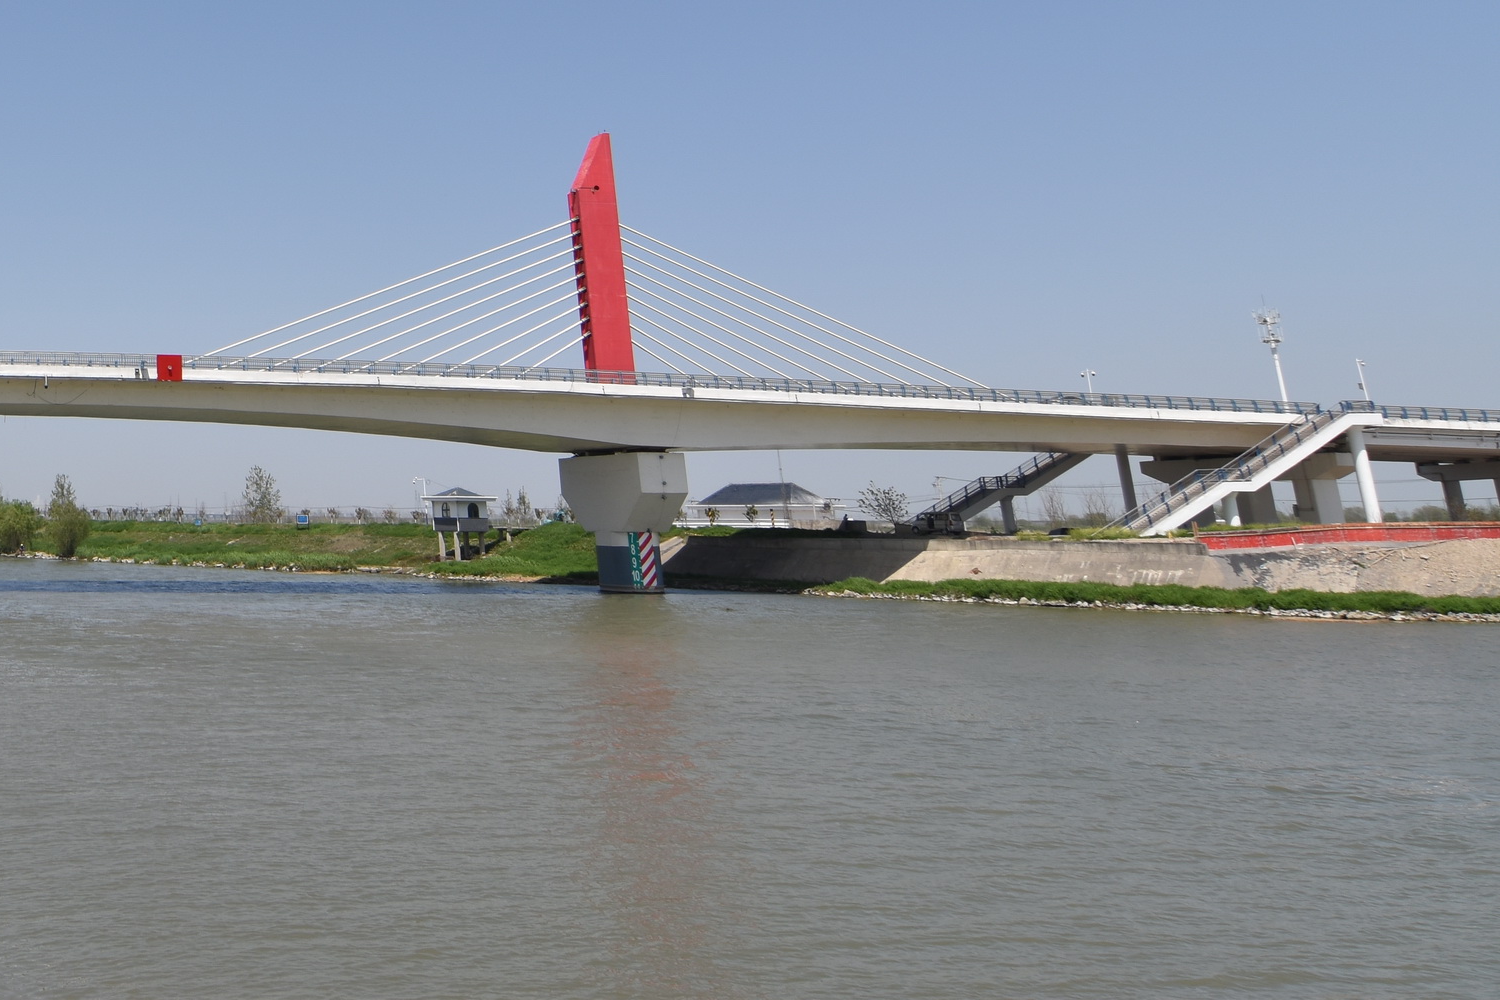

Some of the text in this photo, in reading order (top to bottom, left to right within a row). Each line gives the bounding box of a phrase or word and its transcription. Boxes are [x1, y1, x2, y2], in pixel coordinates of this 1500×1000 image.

[629, 532, 634, 543] 7
[630, 544, 636, 555] 8
[632, 557, 637, 568] 9
[632, 570, 640, 582] 10
